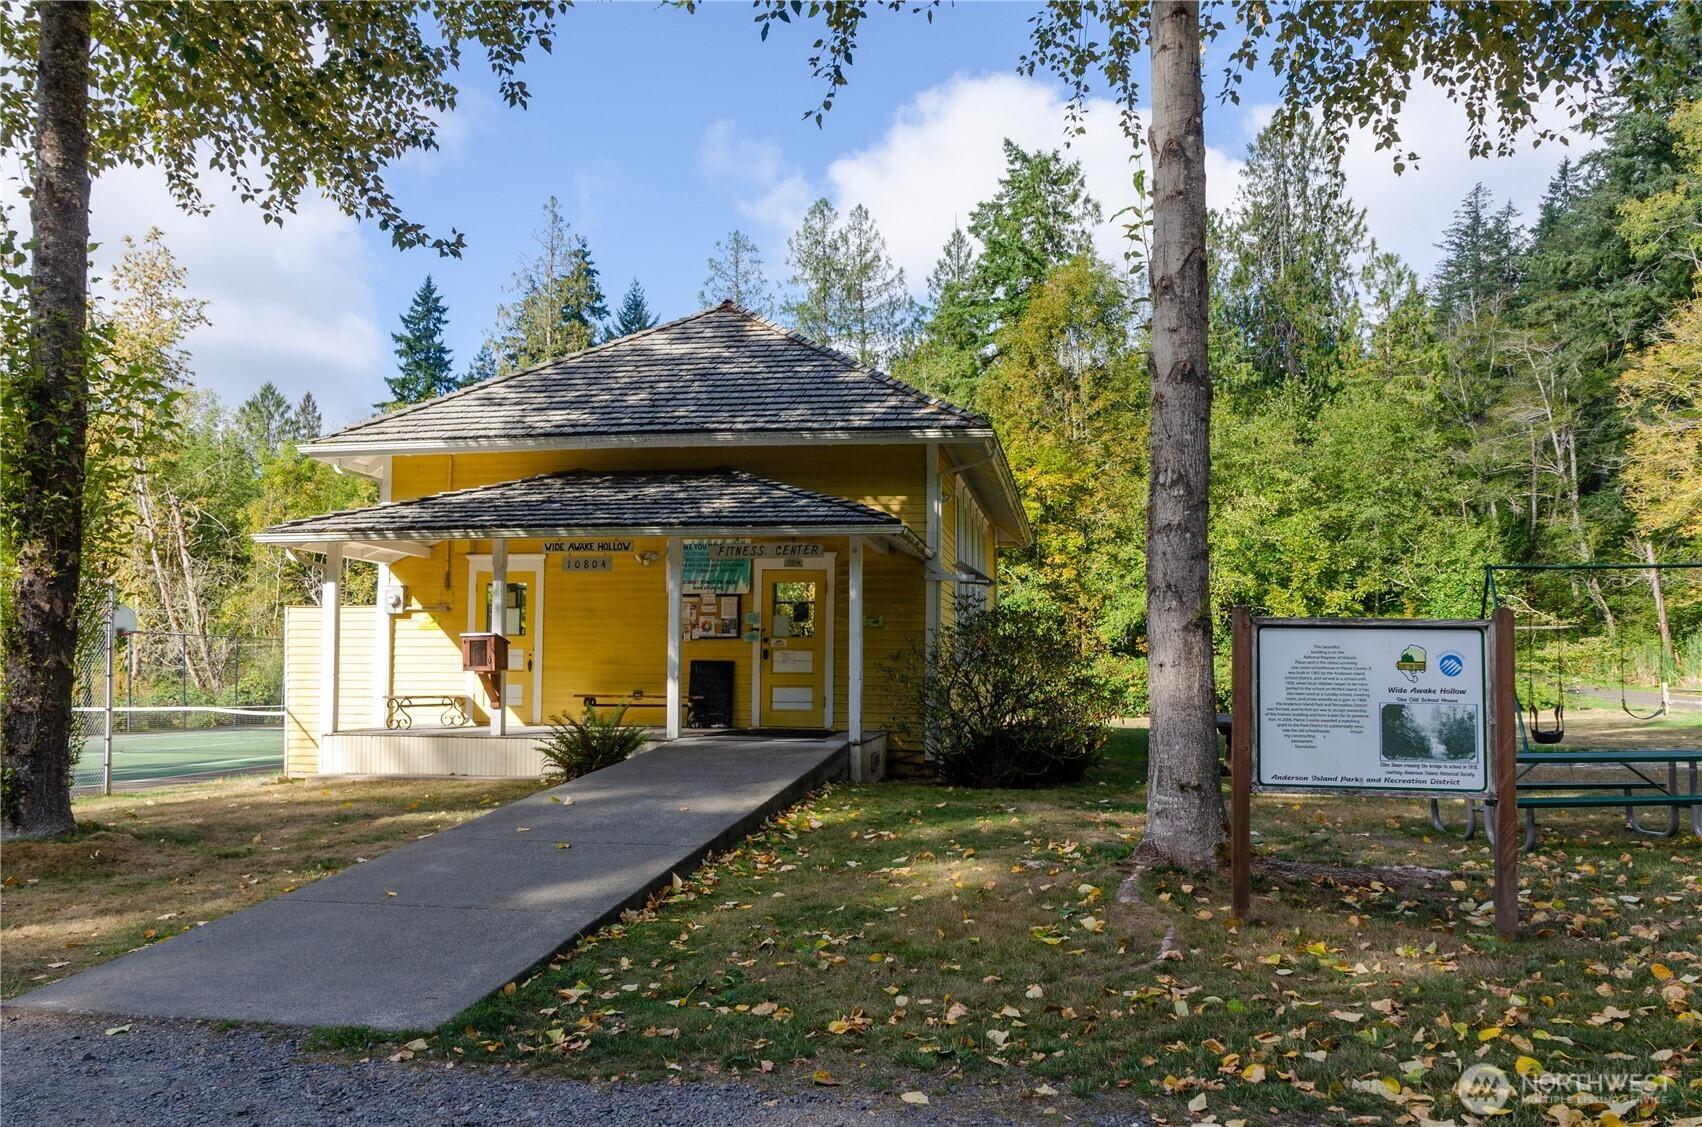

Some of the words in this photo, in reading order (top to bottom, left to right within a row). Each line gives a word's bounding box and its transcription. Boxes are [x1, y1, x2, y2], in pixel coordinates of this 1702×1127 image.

[544, 542, 564, 551] WIDE
[568, 542, 594, 551] AWAKE
[598, 542, 630, 551] HOLLOW
[718, 546, 764, 556] FITNESS
[776, 544, 818, 556] CENTER
[568, 560, 606, 569] 10804
